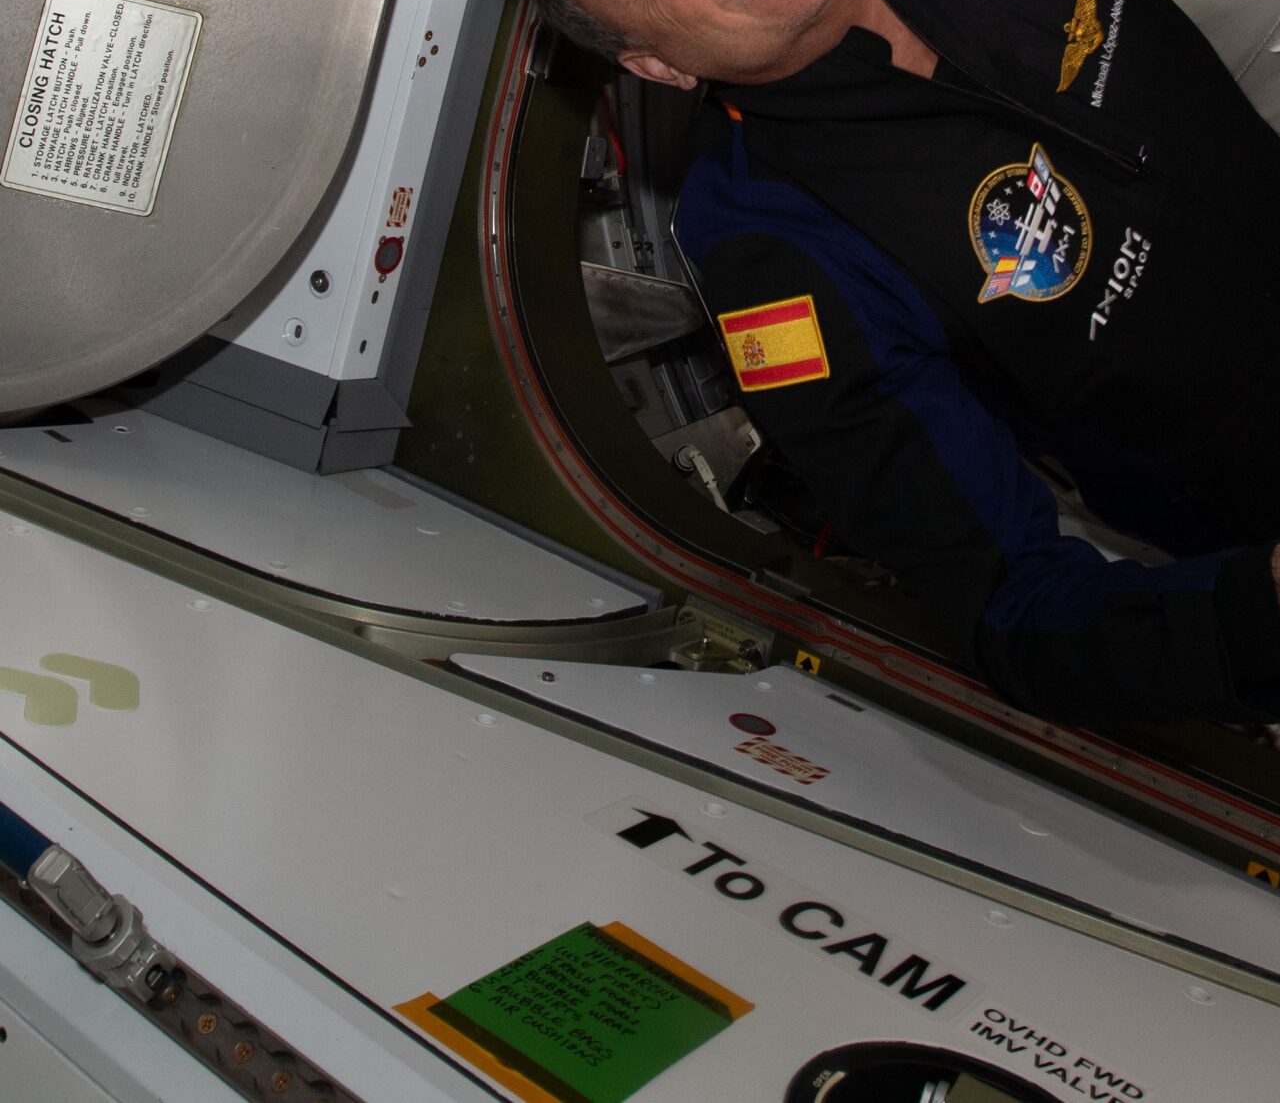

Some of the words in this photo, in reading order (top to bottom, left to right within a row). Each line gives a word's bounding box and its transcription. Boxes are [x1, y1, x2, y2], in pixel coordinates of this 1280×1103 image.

[64, 29, 76, 48] Push.
[101, 2, 124, 69] VALVE-CLOSED.
[123, 37, 136, 70] position.
[19, 76, 49, 148] CLOSING
[39, 12, 65, 70] HATCH
[44, 128, 61, 169] STOWAGE
[56, 97, 69, 125] LATCH
[64, 61, 78, 94] HANDLE
[74, 37, 84, 51] Pull
[80, 13, 91, 35] down.
[53, 58, 68, 92] BUTTON
[112, 72, 127, 107] Engaged
[1088, 59, 1110, 108] Michael
[45, 94, 58, 123] LATCH
[75, 98, 89, 128] Aligned.
[84, 71, 106, 132] EQUALIZATION
[102, 154, 115, 182] CRANK
[111, 119, 125, 151] HANDLE
[122, 91, 132, 108] Turn
[130, 51, 143, 79] LATCH
[139, 14, 153, 49] direction
[54, 143, 67, 171] HATCH
[63, 114, 74, 134] Push
[70, 84, 82, 112] closed.
[83, 139, 99, 178] RATCHET
[96, 102, 109, 130] LATCH
[105, 67, 118, 100] position.
[101, 116, 115, 149] HANDLE
[122, 142, 139, 186] INDICATOR
[136, 94, 152, 133] LATCHED.
[127, 192, 136, 202] 10.
[132, 161, 144, 188] CRANK
[140, 125, 154, 158] HANDLE
[151, 85, 164, 116] Stowed
[161, 50, 174, 83] position.
[33, 125, 50, 167] STOWAGE
[63, 138, 78, 173] ARROWS
[73, 134, 90, 176] PRESSURE
[93, 152, 106, 180] CRANK
[116, 146, 128, 169] travel.
[31, 169, 39, 177] 1.
[60, 176, 68, 184] 4.
[70, 178, 78, 186] 5.
[90, 182, 97, 190] 7.
[113, 172, 121, 183] full
[1052, 225, 1076, 273] AX-1
[1122, 239, 1151, 299] SPACE
[1089, 227, 1141, 341] AXIOM
[550, 956, 596, 984] TRASH
[585, 950, 679, 1001] HIERARCHY
[779, 901, 967, 1011] CAM
[512, 976, 583, 1021] T-SHIRTS
[525, 970, 583, 1006] BUBBLE
[589, 1010, 636, 1035] WRAP
[599, 974, 661, 1010] FIRST)
[488, 996, 520, 1015] AIR
[521, 1015, 606, 1067] CUSHIONS
[496, 985, 567, 1027] BUBBLE
[568, 1029, 613, 1059] BAGS
[970, 1022, 1027, 1053] IMV
[984, 1011, 1067, 1057] OVHD
[1073, 1057, 1143, 1099] FWD
[811, 1069, 831, 1088] OPEN
